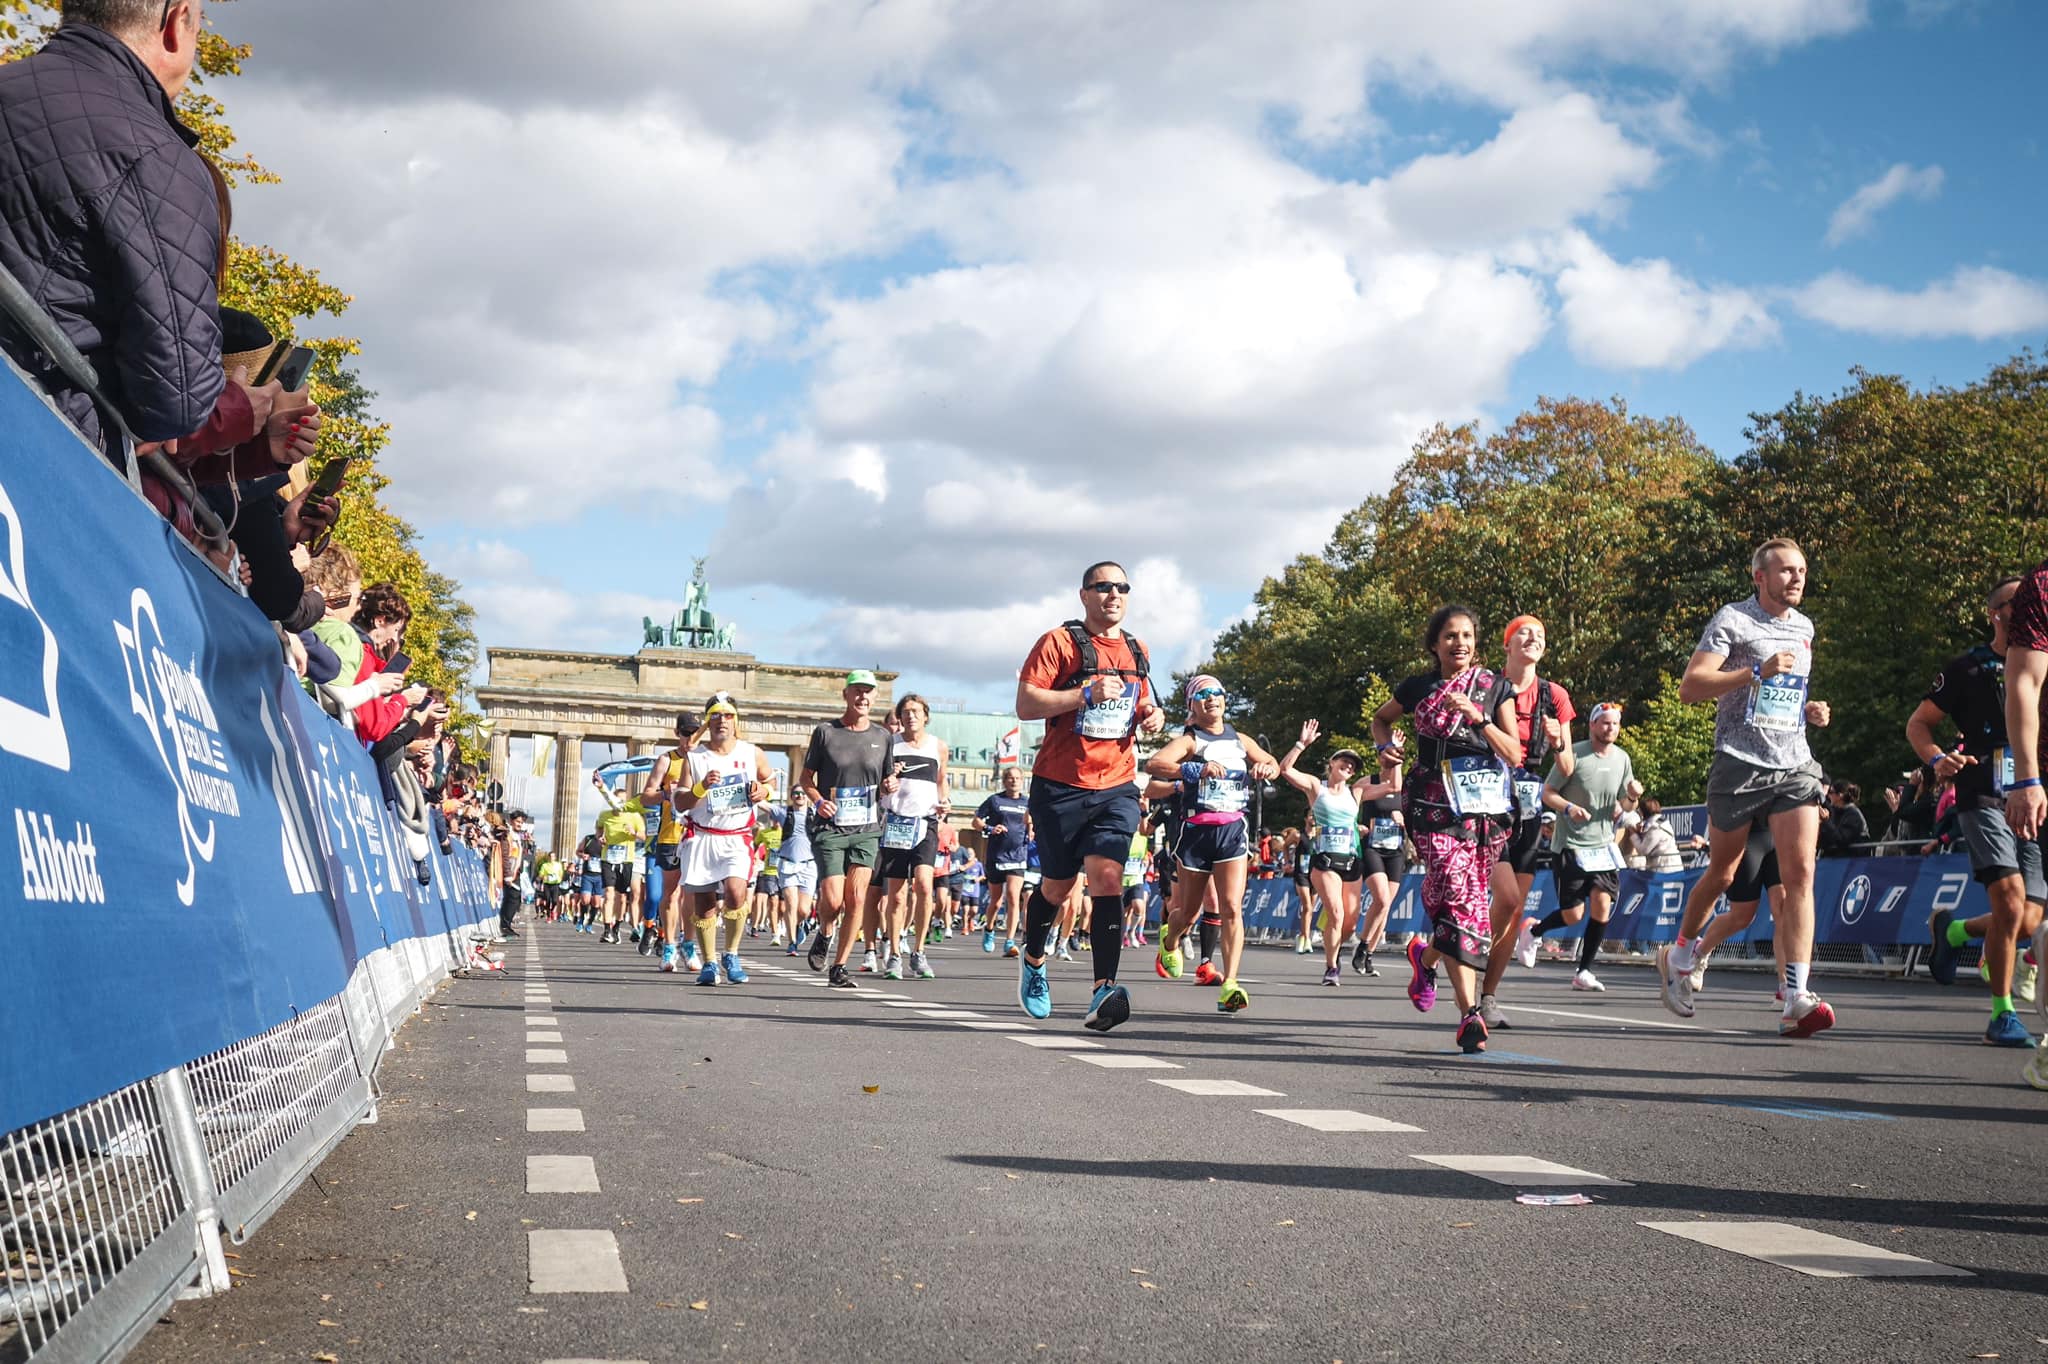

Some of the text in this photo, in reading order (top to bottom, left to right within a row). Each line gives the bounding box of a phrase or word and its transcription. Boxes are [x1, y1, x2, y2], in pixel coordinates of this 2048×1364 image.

[1761, 687, 1800, 704] 32249
[1666, 811, 1694, 837] NDISE
[14, 807, 105, 905] Abbott
